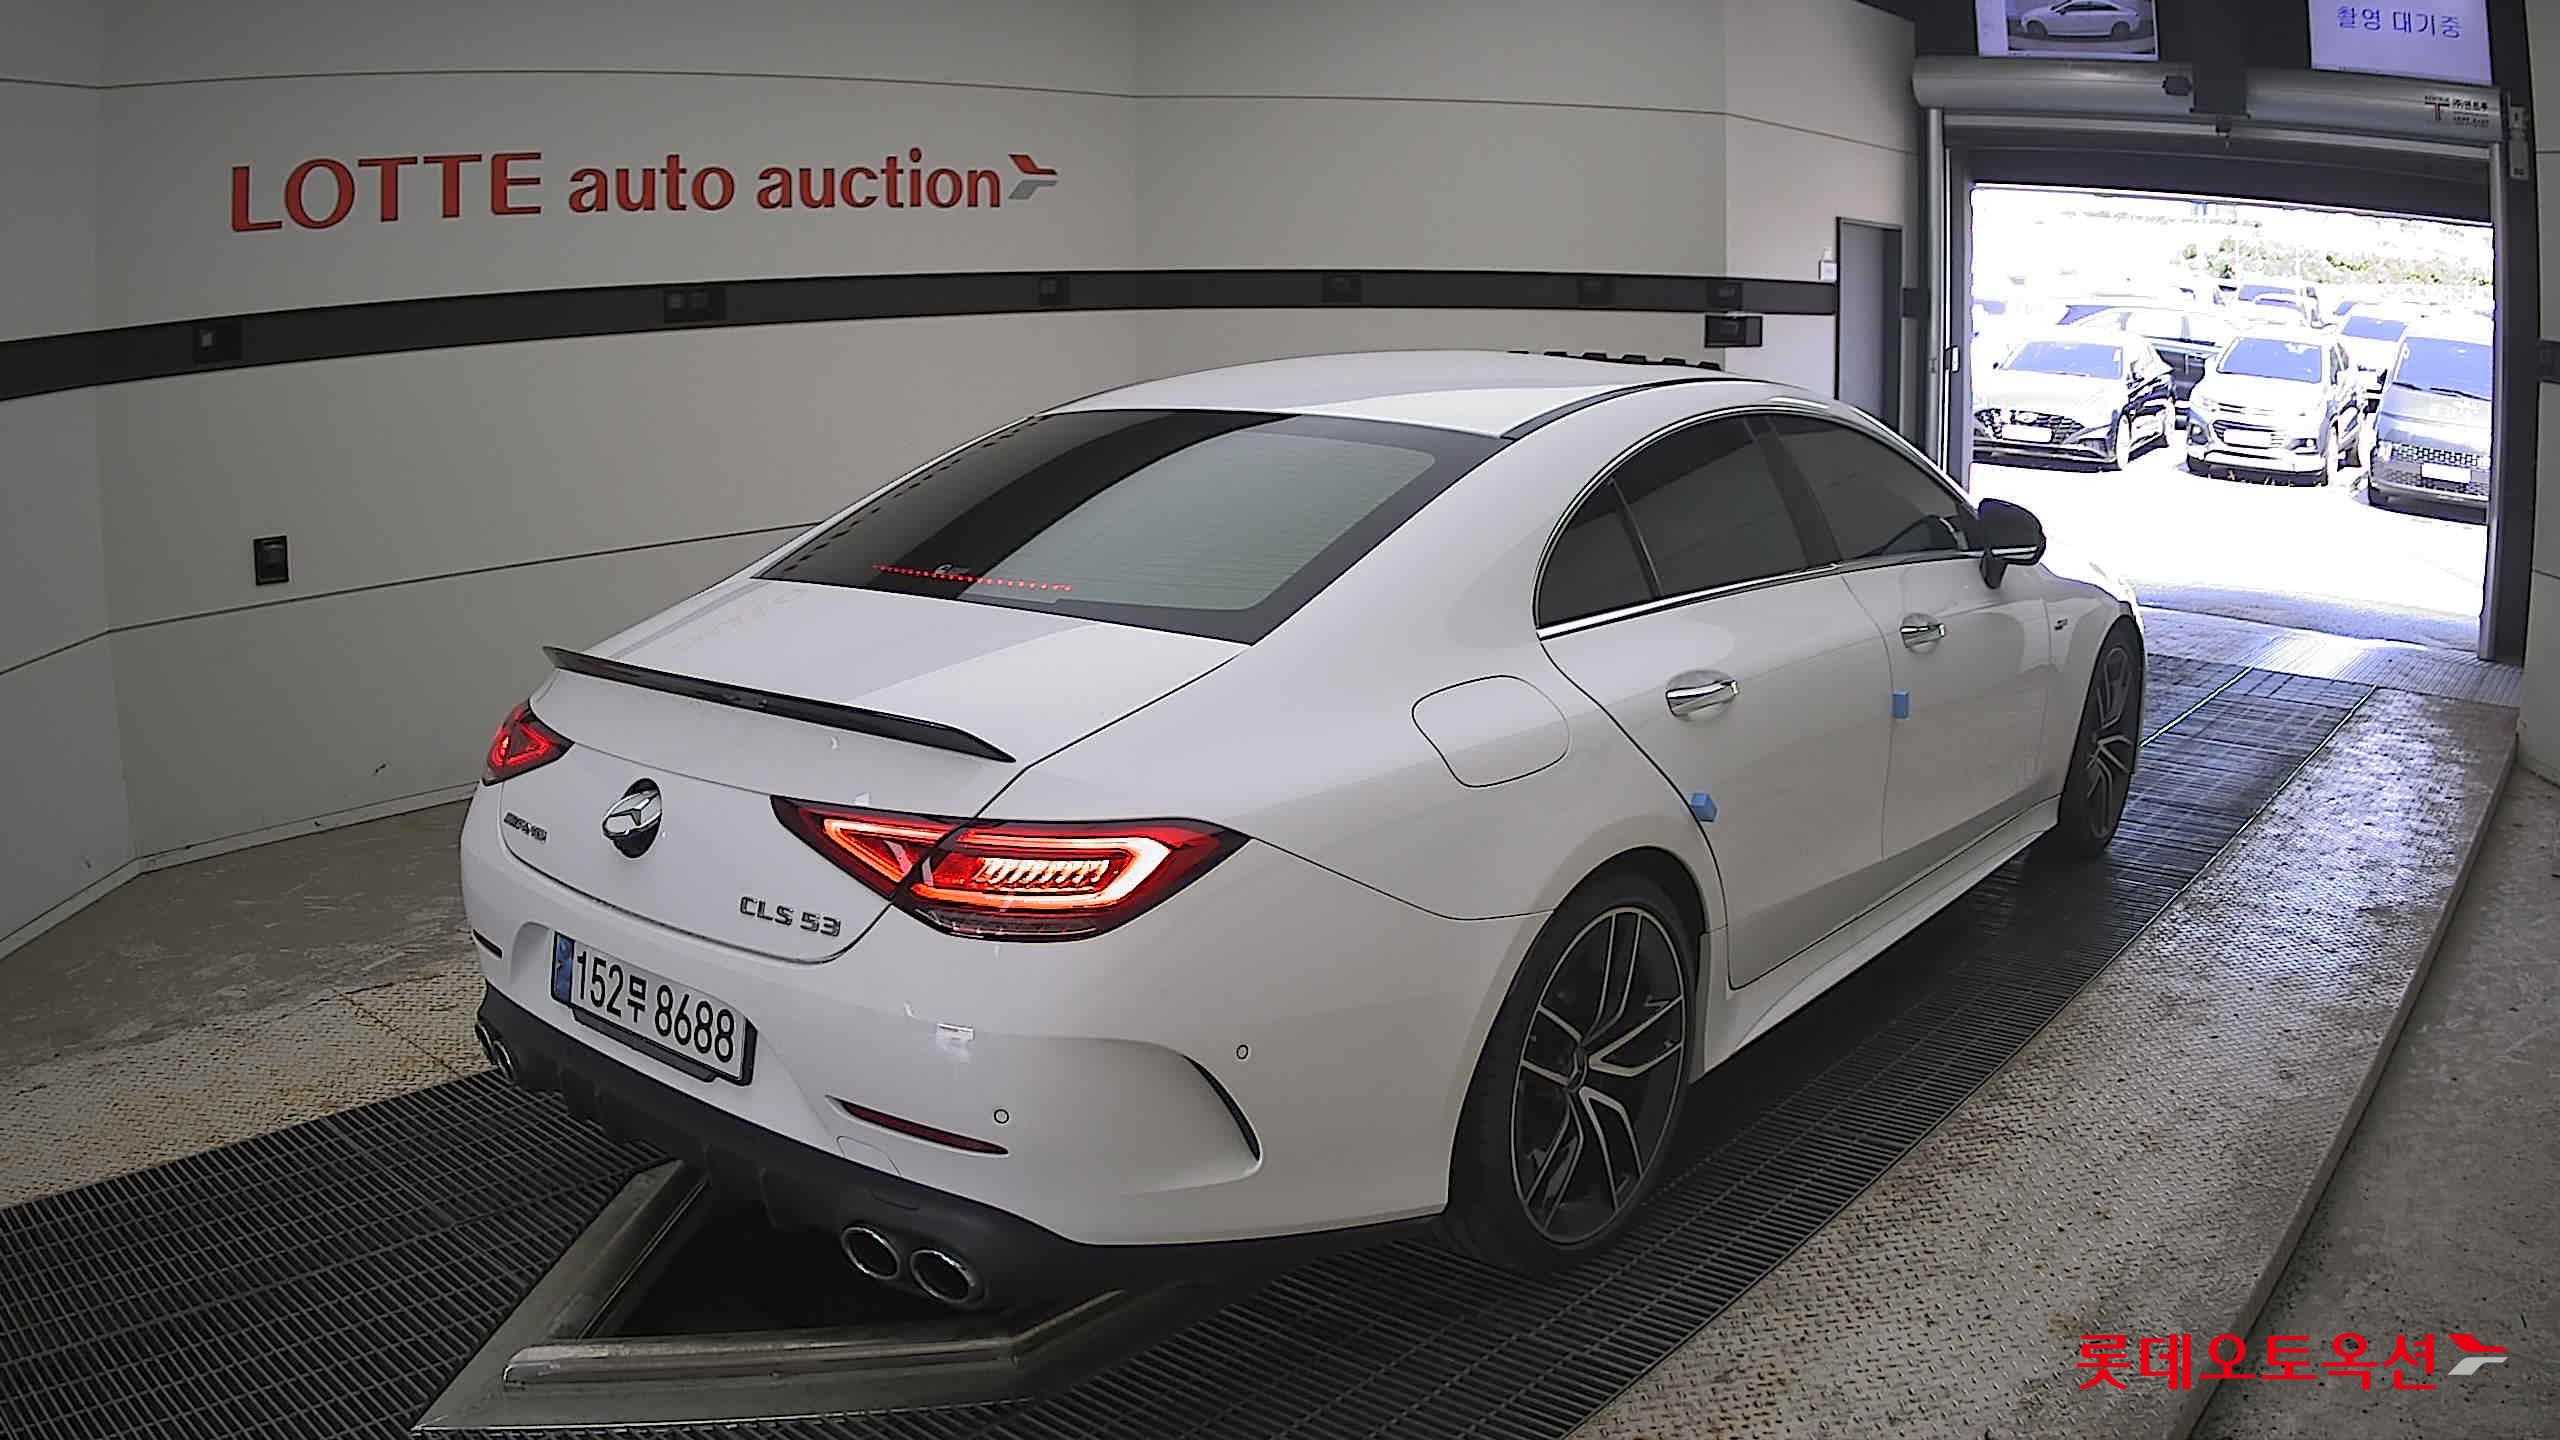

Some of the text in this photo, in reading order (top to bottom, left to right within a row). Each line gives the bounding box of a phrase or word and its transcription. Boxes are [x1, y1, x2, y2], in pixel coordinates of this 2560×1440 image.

[2336, 5, 2462, 39] 촬영 대기중
[231, 147, 1001, 232] LOTTE auto auction
[740, 896, 841, 937] CLS 53
[654, 984, 736, 1063] 8688
